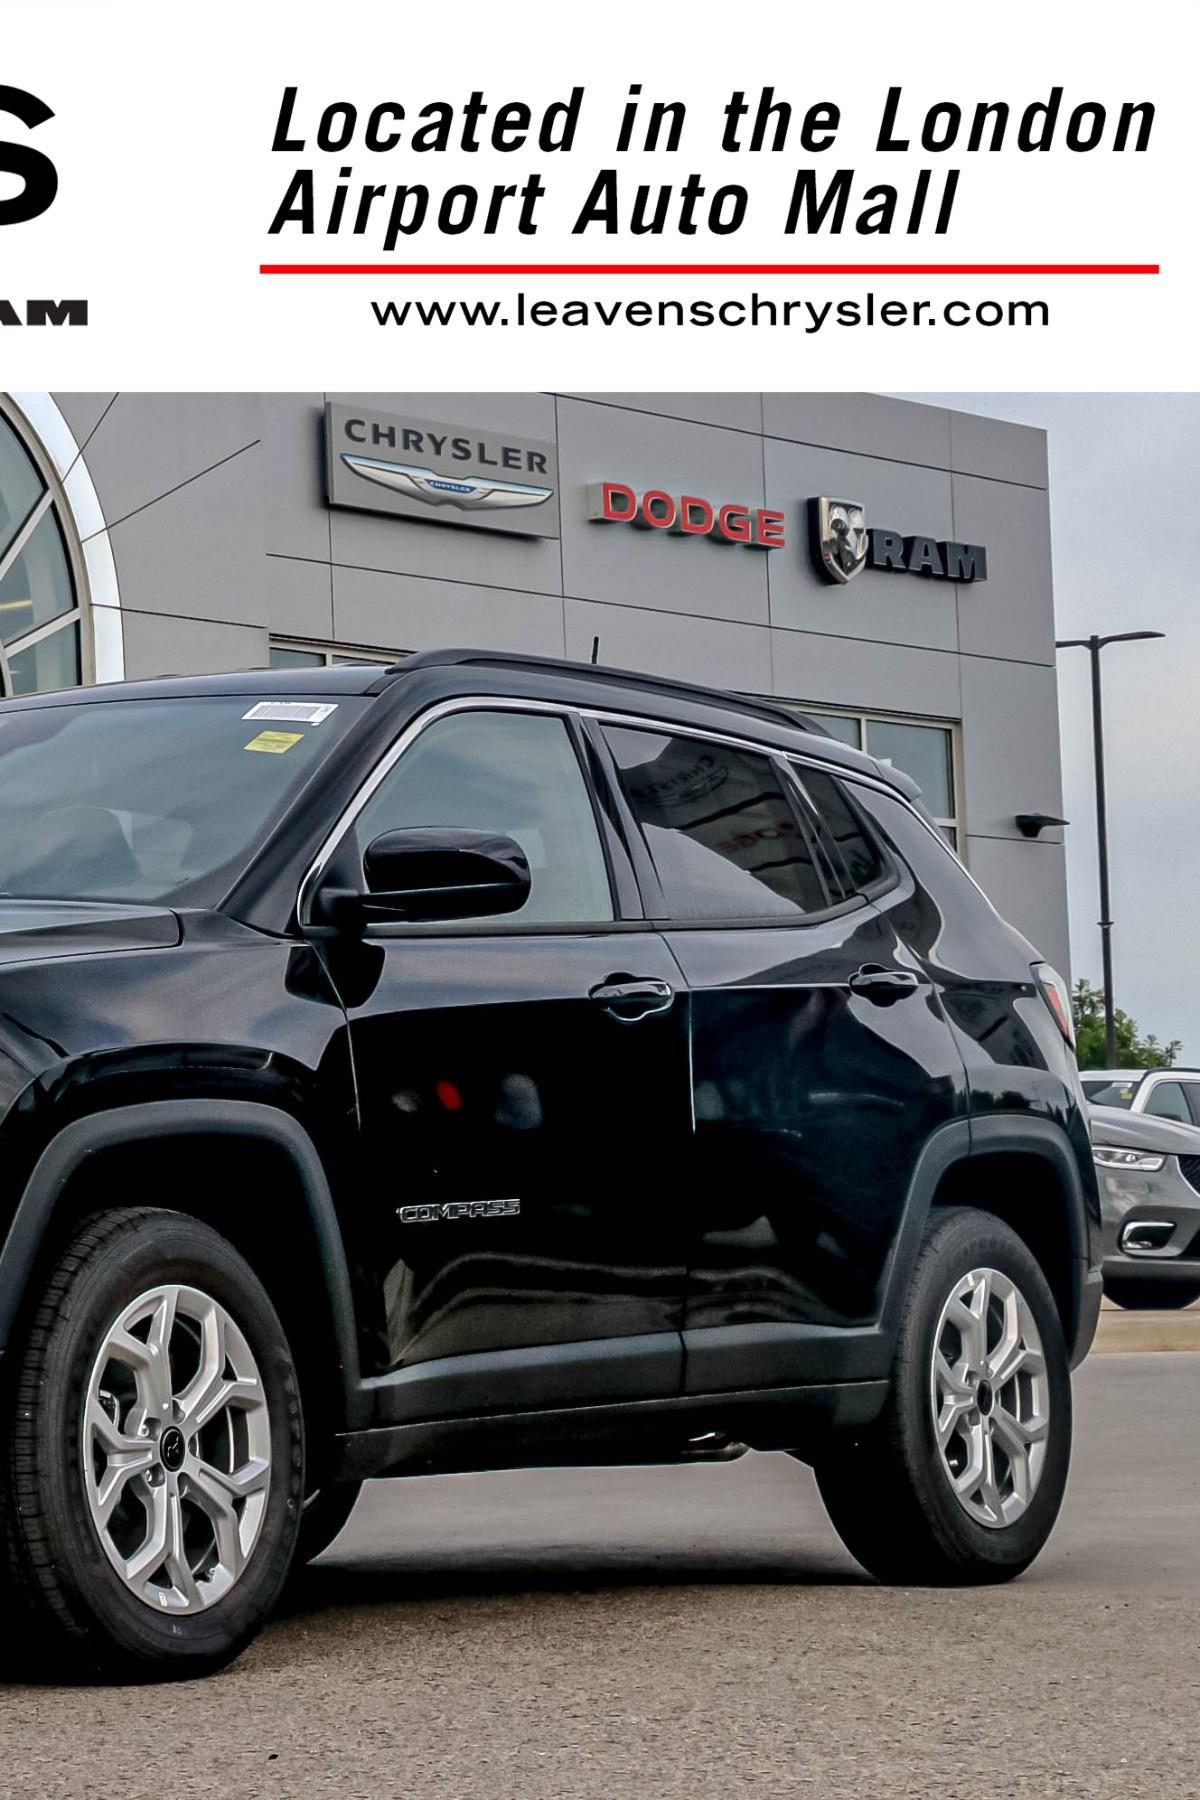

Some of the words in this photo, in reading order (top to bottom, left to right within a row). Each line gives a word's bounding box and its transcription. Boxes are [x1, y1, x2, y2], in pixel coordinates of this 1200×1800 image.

[343, 418, 548, 475] CHRYSLER
[600, 482, 786, 548] DODGE
[869, 528, 988, 583] RAM
[399, 1198, 521, 1223] COMPASS
